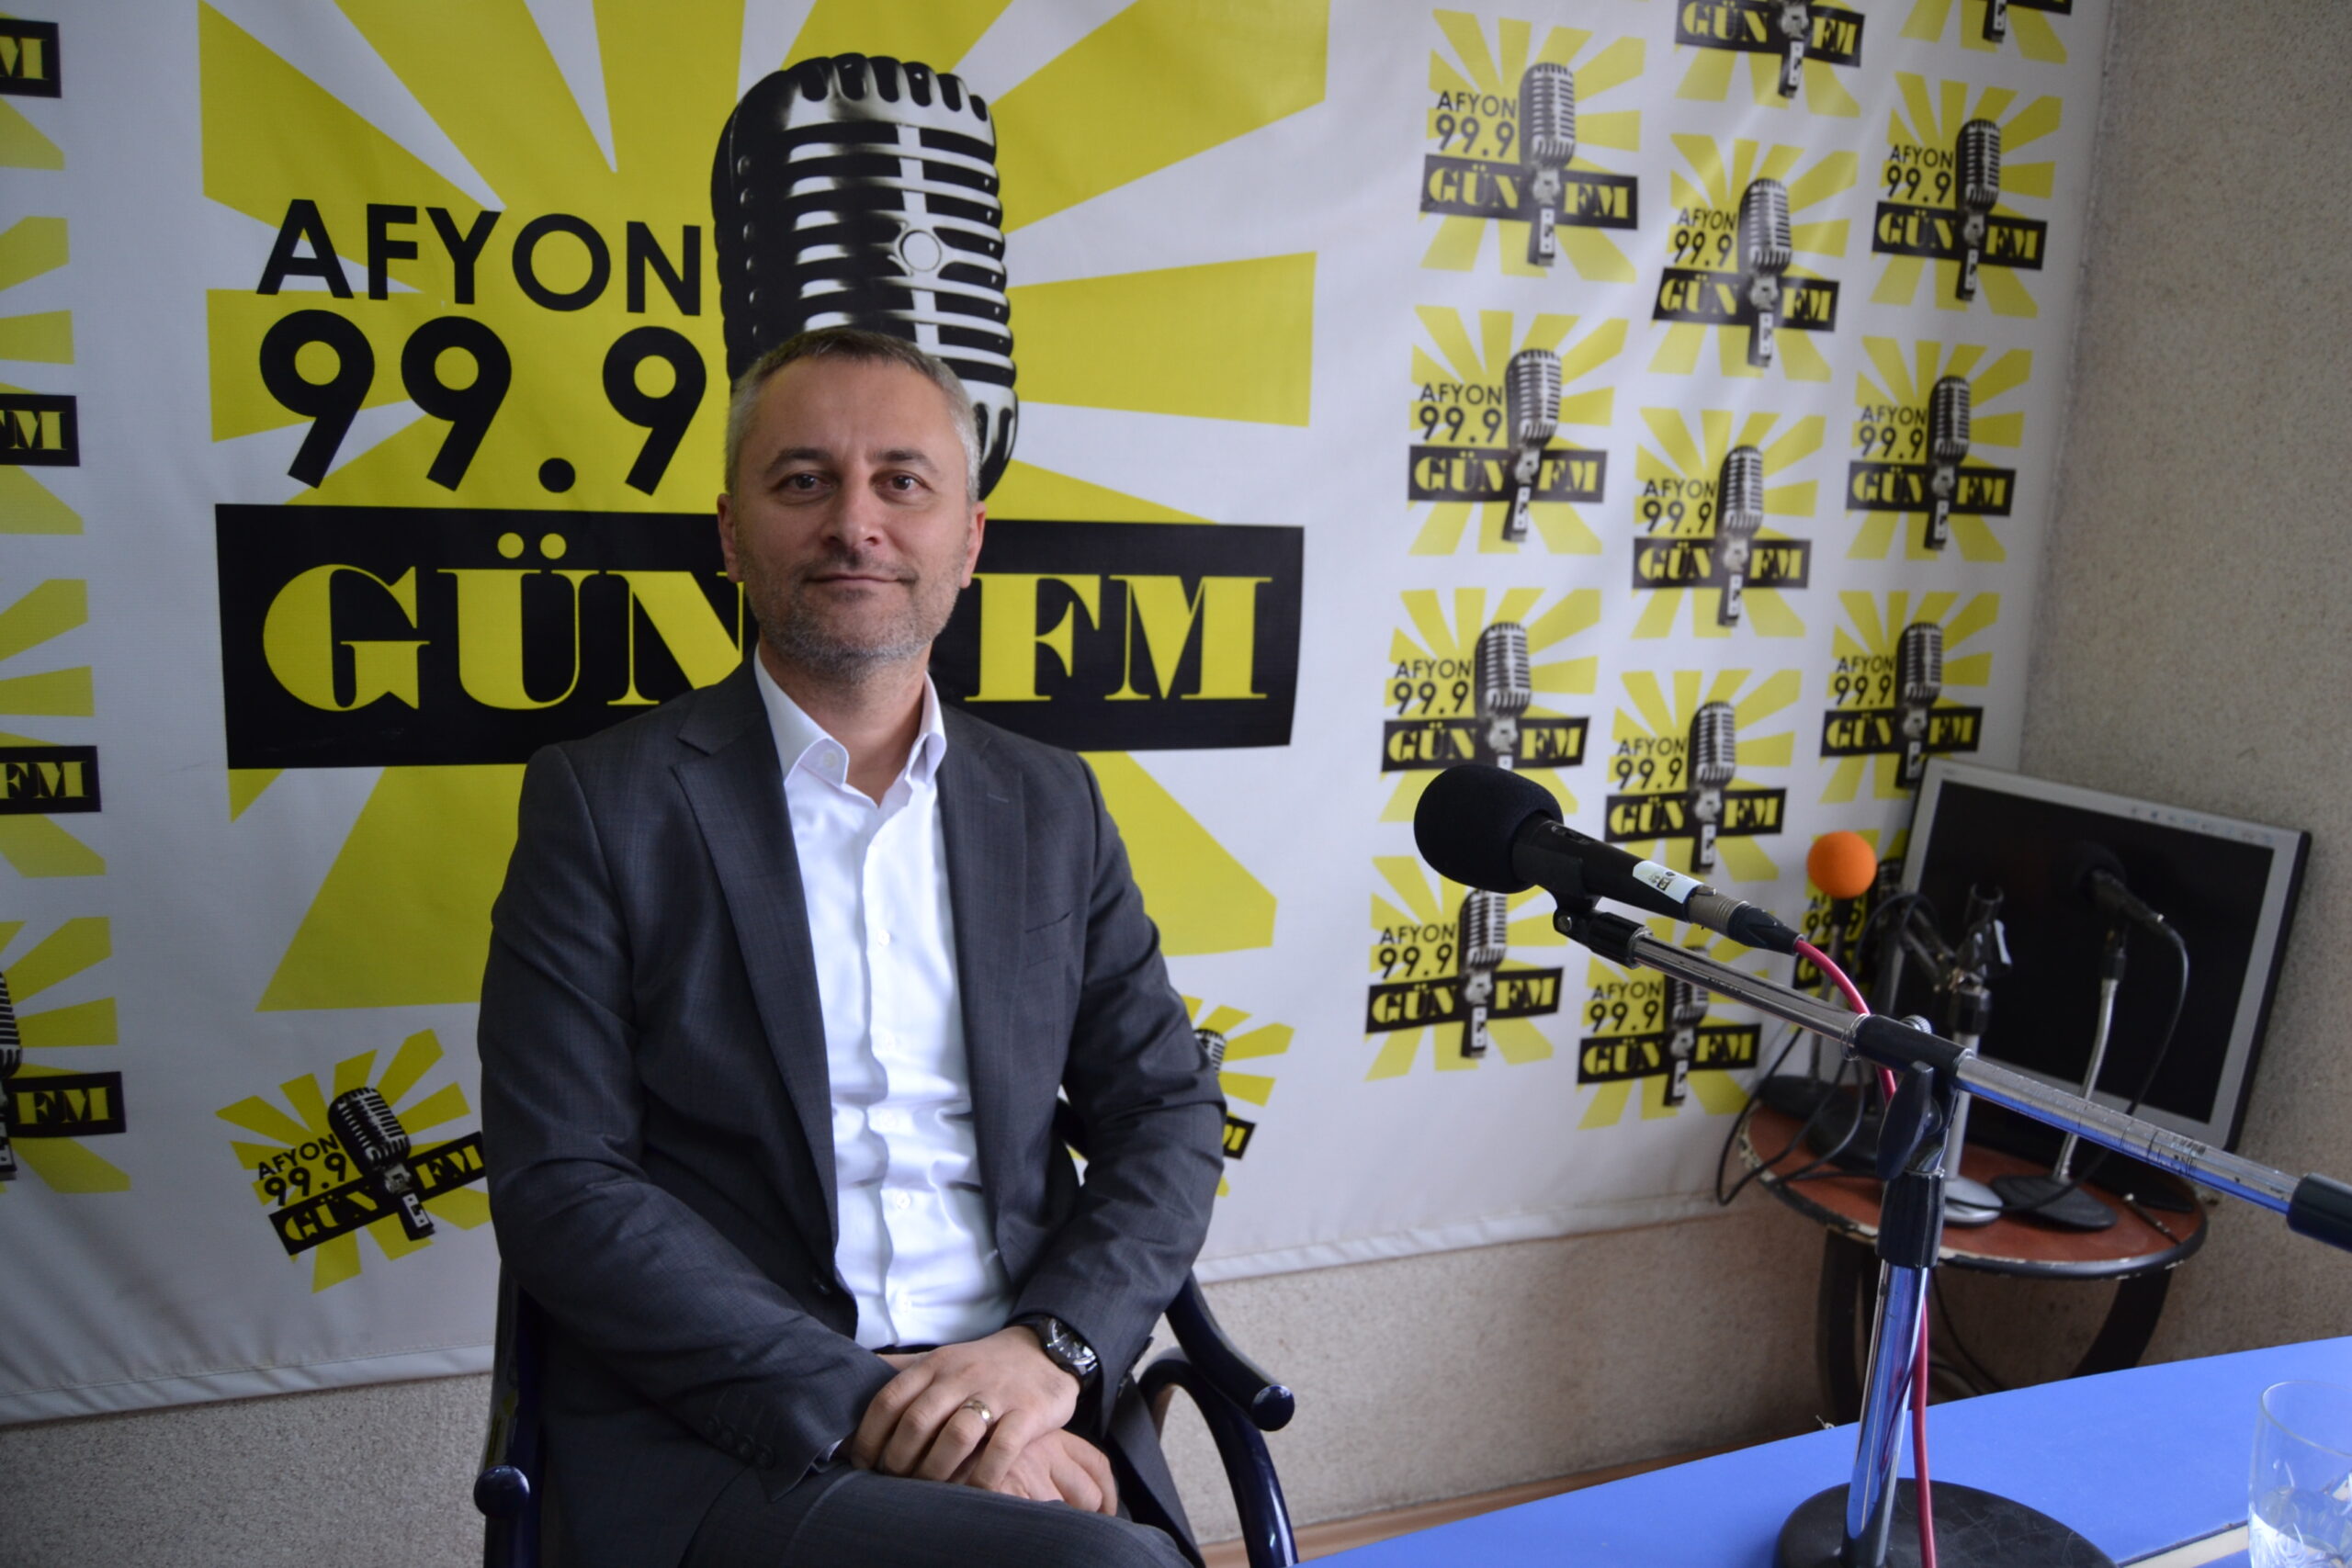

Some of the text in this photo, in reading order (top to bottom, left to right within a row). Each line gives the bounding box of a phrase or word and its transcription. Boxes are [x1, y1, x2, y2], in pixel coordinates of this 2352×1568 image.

[1682, 0, 1857, 55] GÜN FM
[1437, 90, 1516, 118] AFYON
[1436, 114, 1515, 158] 99.9
[1890, 145, 1952, 167] AFYON
[1428, 164, 1630, 220] GÜN FM
[1887, 165, 1951, 204] 99.9
[1678, 208, 1736, 230] AFYON
[1878, 209, 2038, 260] GÜN FM
[256, 199, 701, 316] AFYON
[1674, 230, 1733, 267] 99.9
[1659, 275, 1832, 321] GÜN FM
[259, 310, 707, 496] 99.9
[1419, 382, 1502, 405] AFYON
[1419, 406, 1502, 443] 99.9
[1861, 404, 1925, 425] AFYON
[1859, 426, 1924, 459] 99.9
[1415, 450, 1598, 492] GÜN FM
[1644, 479, 1716, 498] AFYON
[1852, 466, 2007, 506] GÜN FM
[1643, 501, 1713, 534] 99.9
[1639, 542, 1803, 579] GÜN FM
[263, 532, 1272, 711] GÜN FM
[1396, 660, 1471, 679] AFYON
[1837, 655, 1894, 673] AFYON
[1394, 681, 1469, 716] 99.9
[1835, 675, 1892, 706] 99.9
[1388, 722, 1582, 761] GÜN FM
[1617, 737, 1685, 756] AFYON
[1826, 712, 1974, 749] GÜN FM
[1616, 758, 1682, 790] 99.9
[1610, 796, 1779, 835] GÜN FM
[1379, 923, 1455, 944] AFYON
[1379, 943, 1453, 979] 99.9
[1371, 976, 1556, 1024] GÜN FM
[1592, 981, 1661, 1000] AFYON
[1590, 999, 1659, 1032] 99.9
[1583, 1032, 1754, 1075] GÜN FM
[13, 1087, 115, 1124] FM
[258, 1134, 340, 1180] AFYON
[264, 1152, 346, 1207] 99.9
[285, 1145, 484, 1240] GÜN FM
